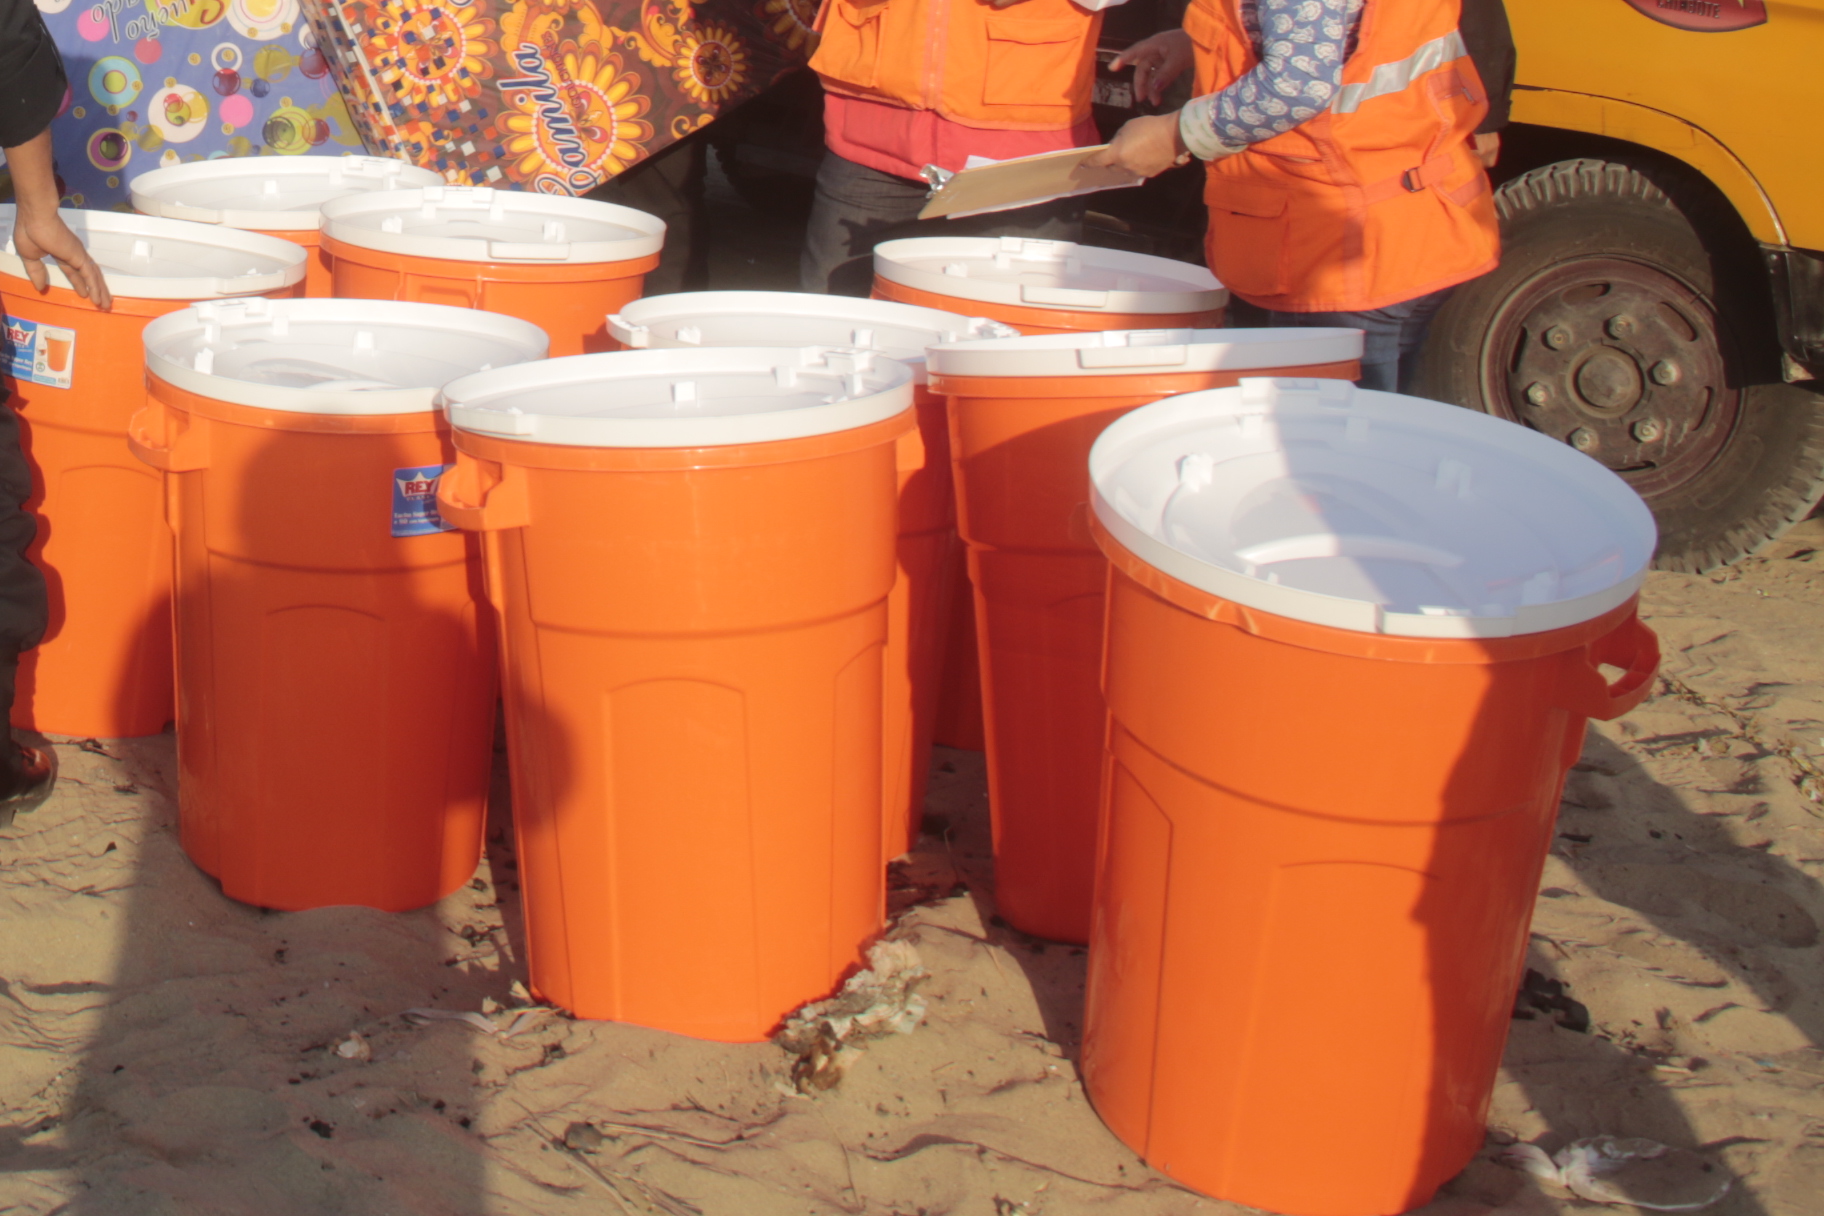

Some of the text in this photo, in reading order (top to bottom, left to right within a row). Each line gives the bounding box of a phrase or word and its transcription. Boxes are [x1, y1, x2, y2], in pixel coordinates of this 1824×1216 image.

[541, 30, 583, 109] COLCHONES
[6, 327, 29, 344] REY
[404, 479, 436, 496] REY
